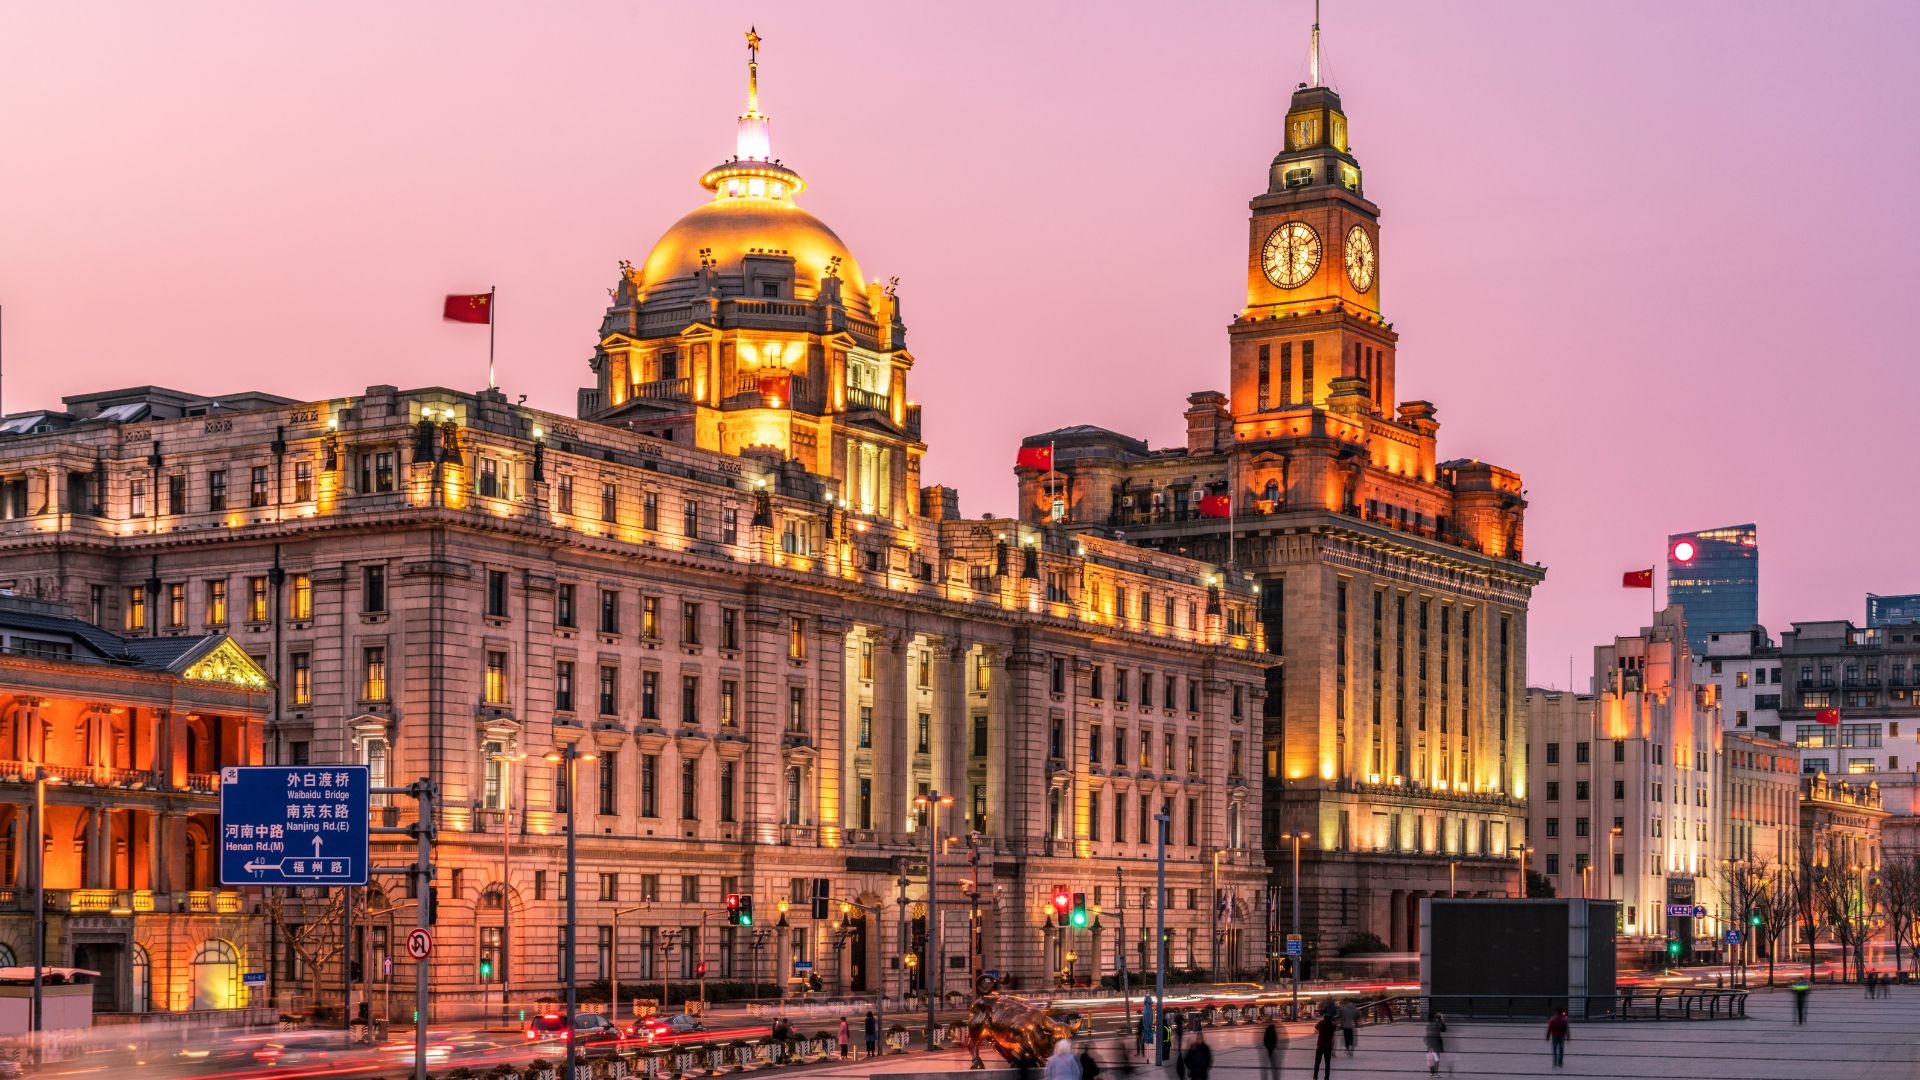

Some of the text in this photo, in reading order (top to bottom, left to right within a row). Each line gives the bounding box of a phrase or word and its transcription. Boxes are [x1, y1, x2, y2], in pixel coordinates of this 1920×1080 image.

[228, 769, 236, 778] 北
[287, 772, 349, 787] 外白渡桥
[287, 790, 349, 801] Waibaidu Bridge
[287, 804, 349, 818] 南京东路
[225, 824, 284, 838] 河南中路
[287, 822, 349, 832] Nanjing Rd.(E)
[226, 842, 284, 853] Henan Rd.(M)
[255, 857, 265, 865] 40
[293, 861, 342, 873] 福州路
[254, 870, 264, 878] 17
